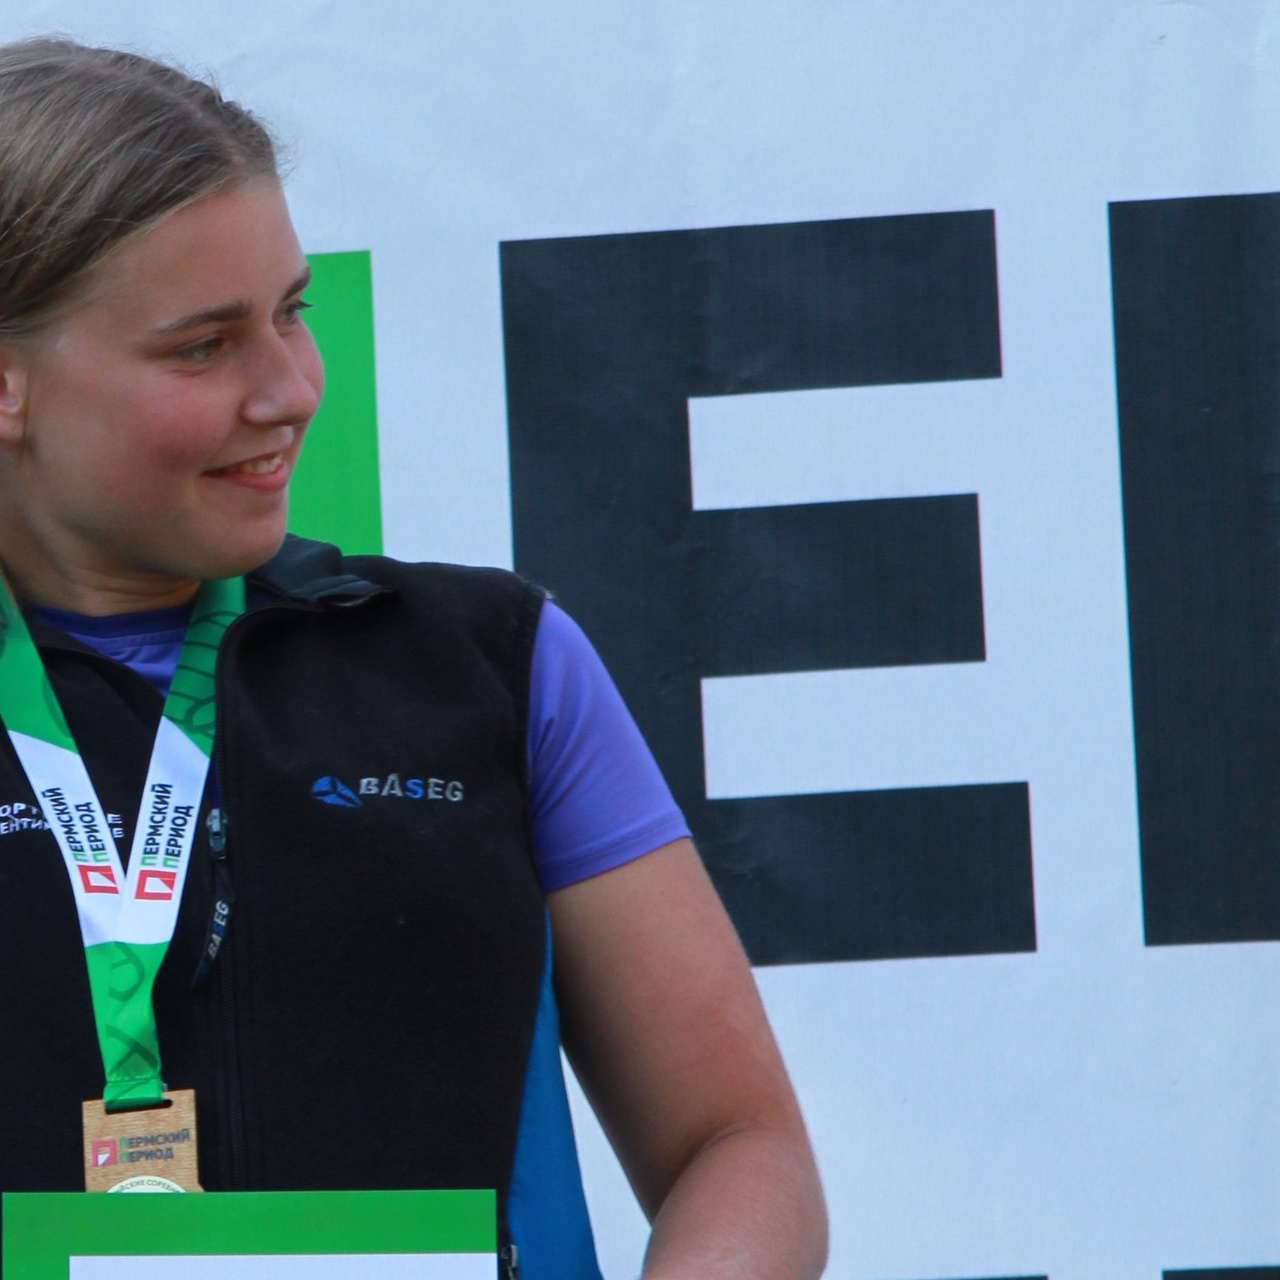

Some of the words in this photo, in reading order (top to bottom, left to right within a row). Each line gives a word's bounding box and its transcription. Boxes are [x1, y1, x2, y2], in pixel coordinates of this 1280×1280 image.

[359, 773, 464, 801] BASEG
[41, 787, 89, 862] ПЕРМСКИЙ
[74, 801, 110, 862] ПЕРИОД
[141, 782, 173, 866] ПЕРМСКИЙ
[162, 805, 194, 869] ПЕРИОД
[117, 1128, 190, 1148] ПЕРМСКИЙ
[118, 1147, 174, 1163] ПЕРИОД
